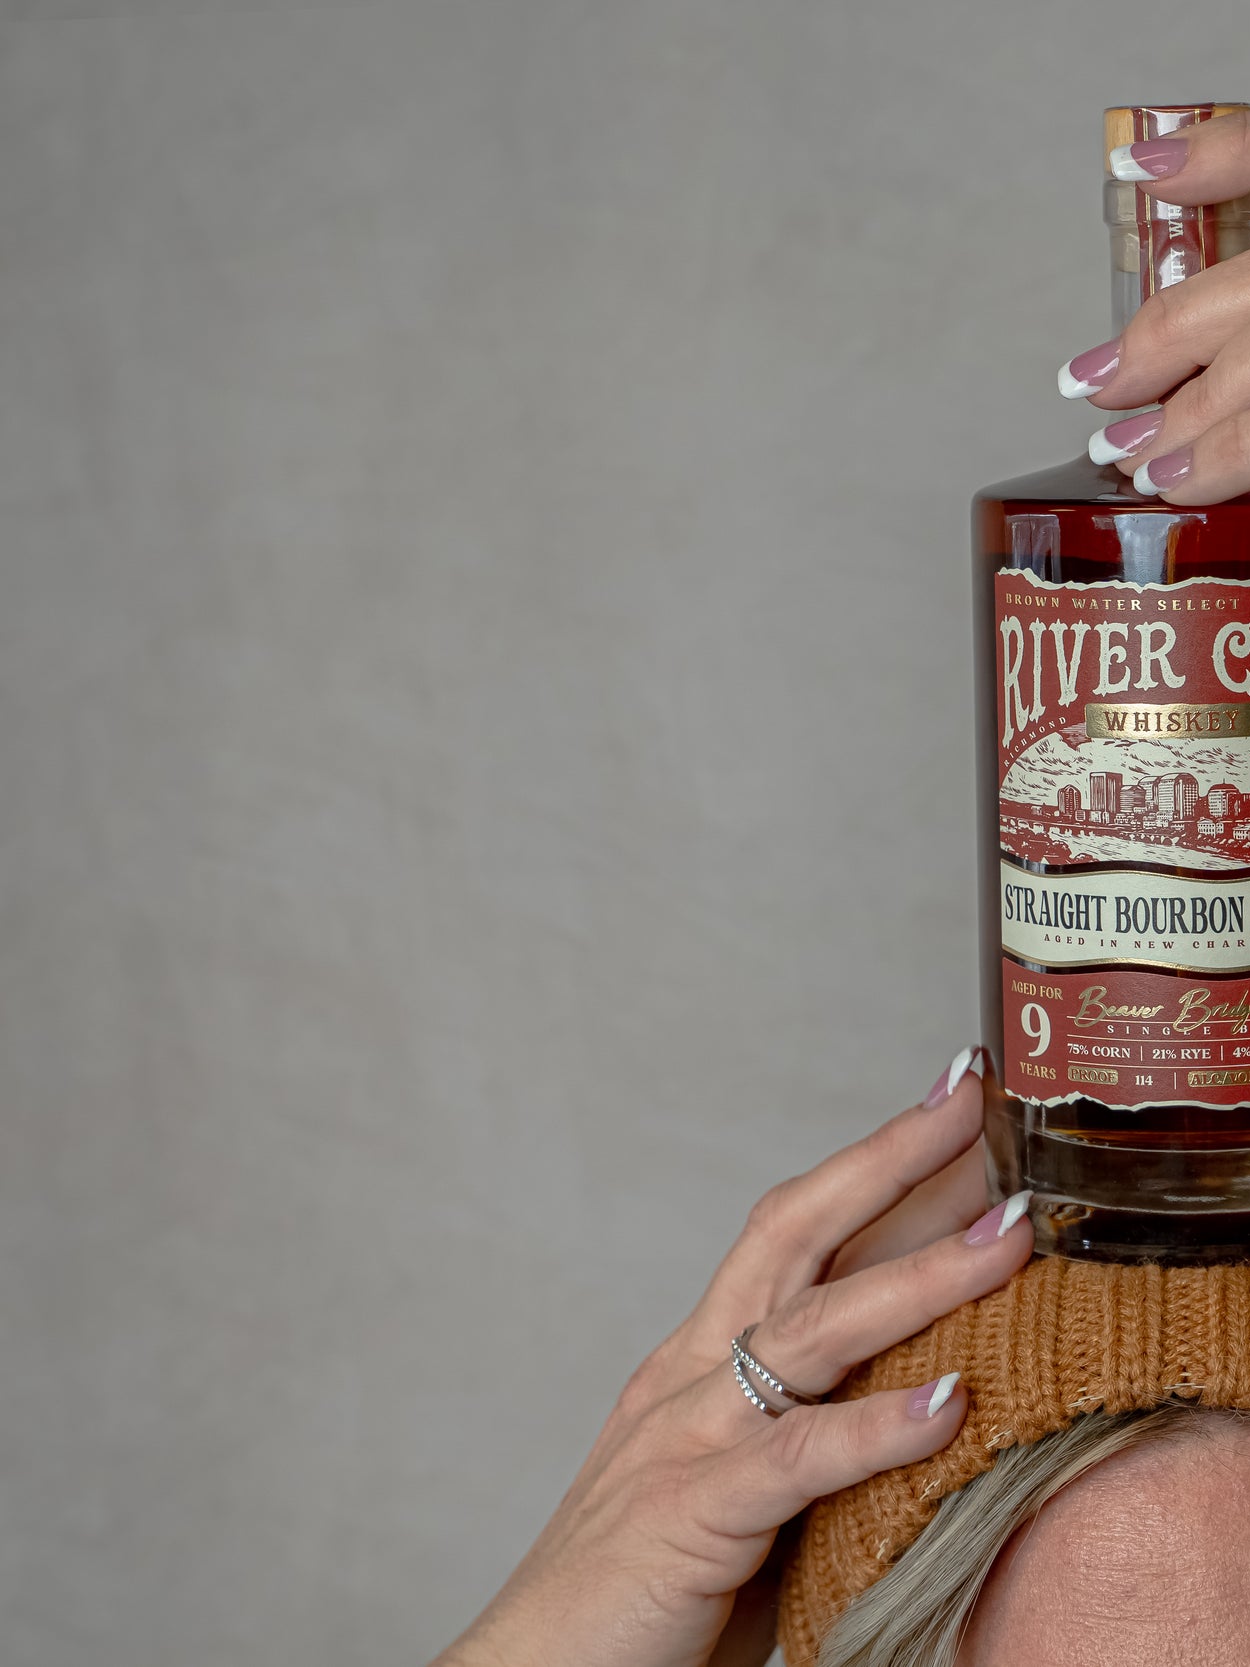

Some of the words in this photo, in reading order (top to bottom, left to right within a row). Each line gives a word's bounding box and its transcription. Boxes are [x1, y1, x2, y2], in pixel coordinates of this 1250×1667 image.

[1171, 247, 1185, 281] ITY
[1006, 593, 1059, 608] BROWN
[1072, 598, 1141, 611] WATER
[1157, 598, 1240, 611] SELECT
[1000, 615, 1186, 748] RIVER
[1105, 710, 1240, 732] WHISKEY
[1003, 716, 1066, 767] RICHMOND
[1005, 884, 1107, 932] STRAIGHT
[1115, 895, 1245, 935] BOURBON
[1044, 934, 1085, 946] AGED
[1100, 940, 1117, 948] IN
[1134, 941, 1174, 949] NEW
[1012, 980, 1036, 996] AGED
[1040, 986, 1063, 1000] FOR
[1074, 985, 1164, 1028] Beaver
[1021, 1003, 1051, 1057] 9
[1067, 1043, 1089, 1056] 75%
[1092, 1046, 1131, 1058] CORN
[1152, 1048, 1177, 1060] 21%
[1180, 1049, 1211, 1060] RYE
[1020, 1062, 1056, 1080] YEARS
[1071, 1069, 1117, 1083] PROOF
[1135, 1075, 1153, 1086] 114
